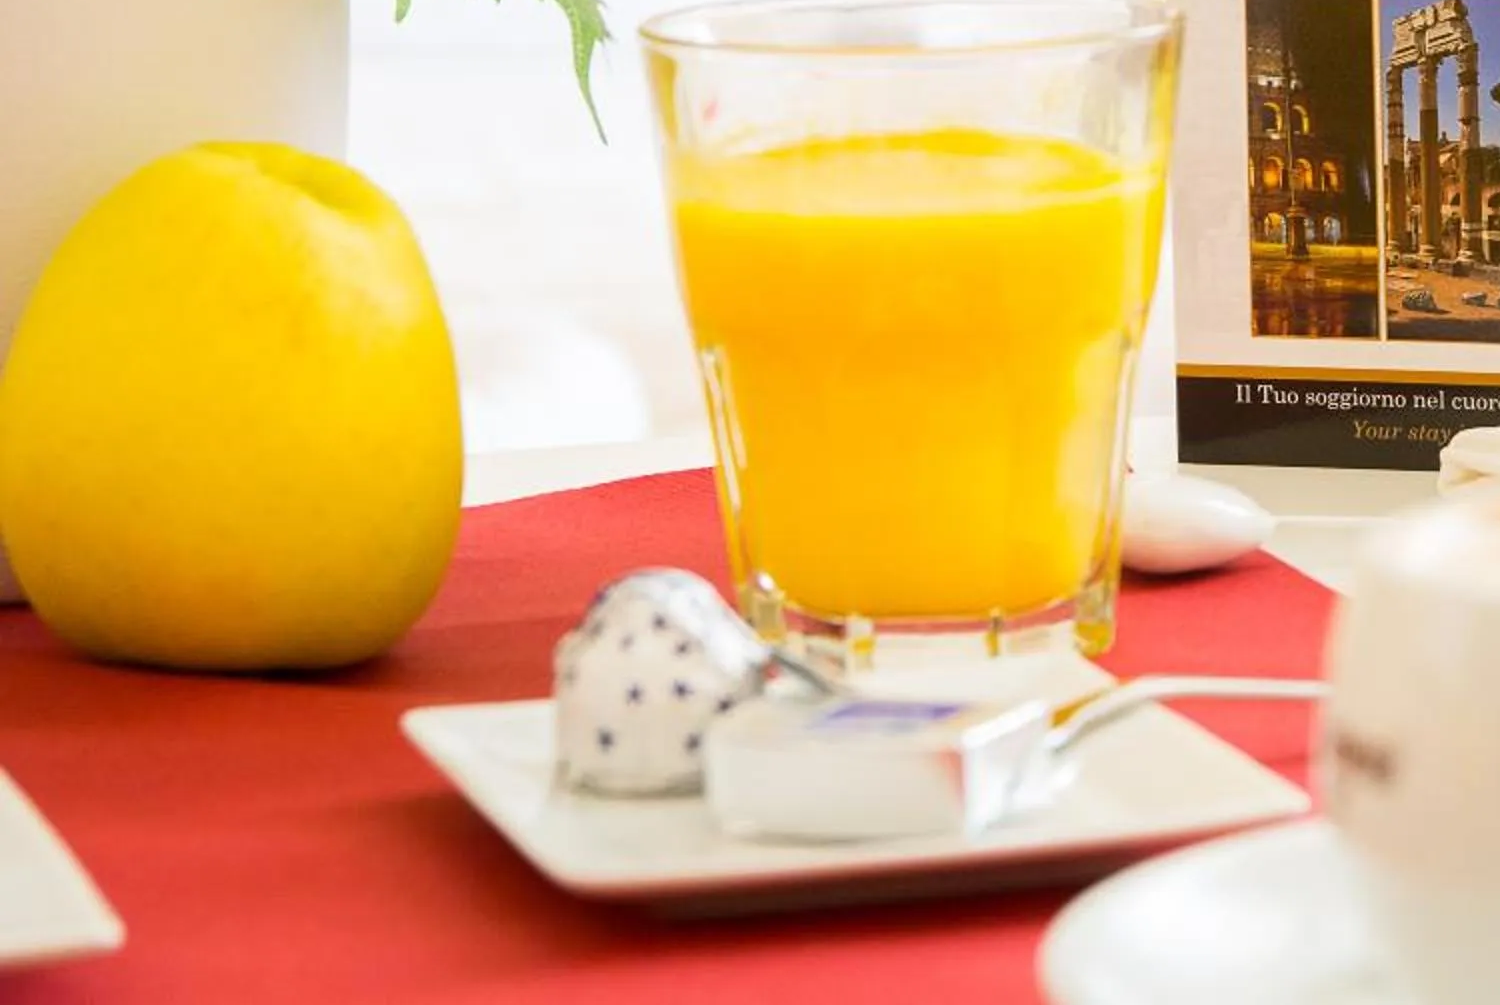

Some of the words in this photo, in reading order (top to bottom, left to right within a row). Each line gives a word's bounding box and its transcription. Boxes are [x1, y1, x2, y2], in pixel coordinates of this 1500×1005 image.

[1235, 383, 1251, 404] Il
[1257, 384, 1299, 404] Tuo
[1305, 387, 1407, 410] soggiorno
[1413, 390, 1445, 410] nel
[1353, 420, 1403, 441] Your
[1407, 424, 1451, 445] stay
